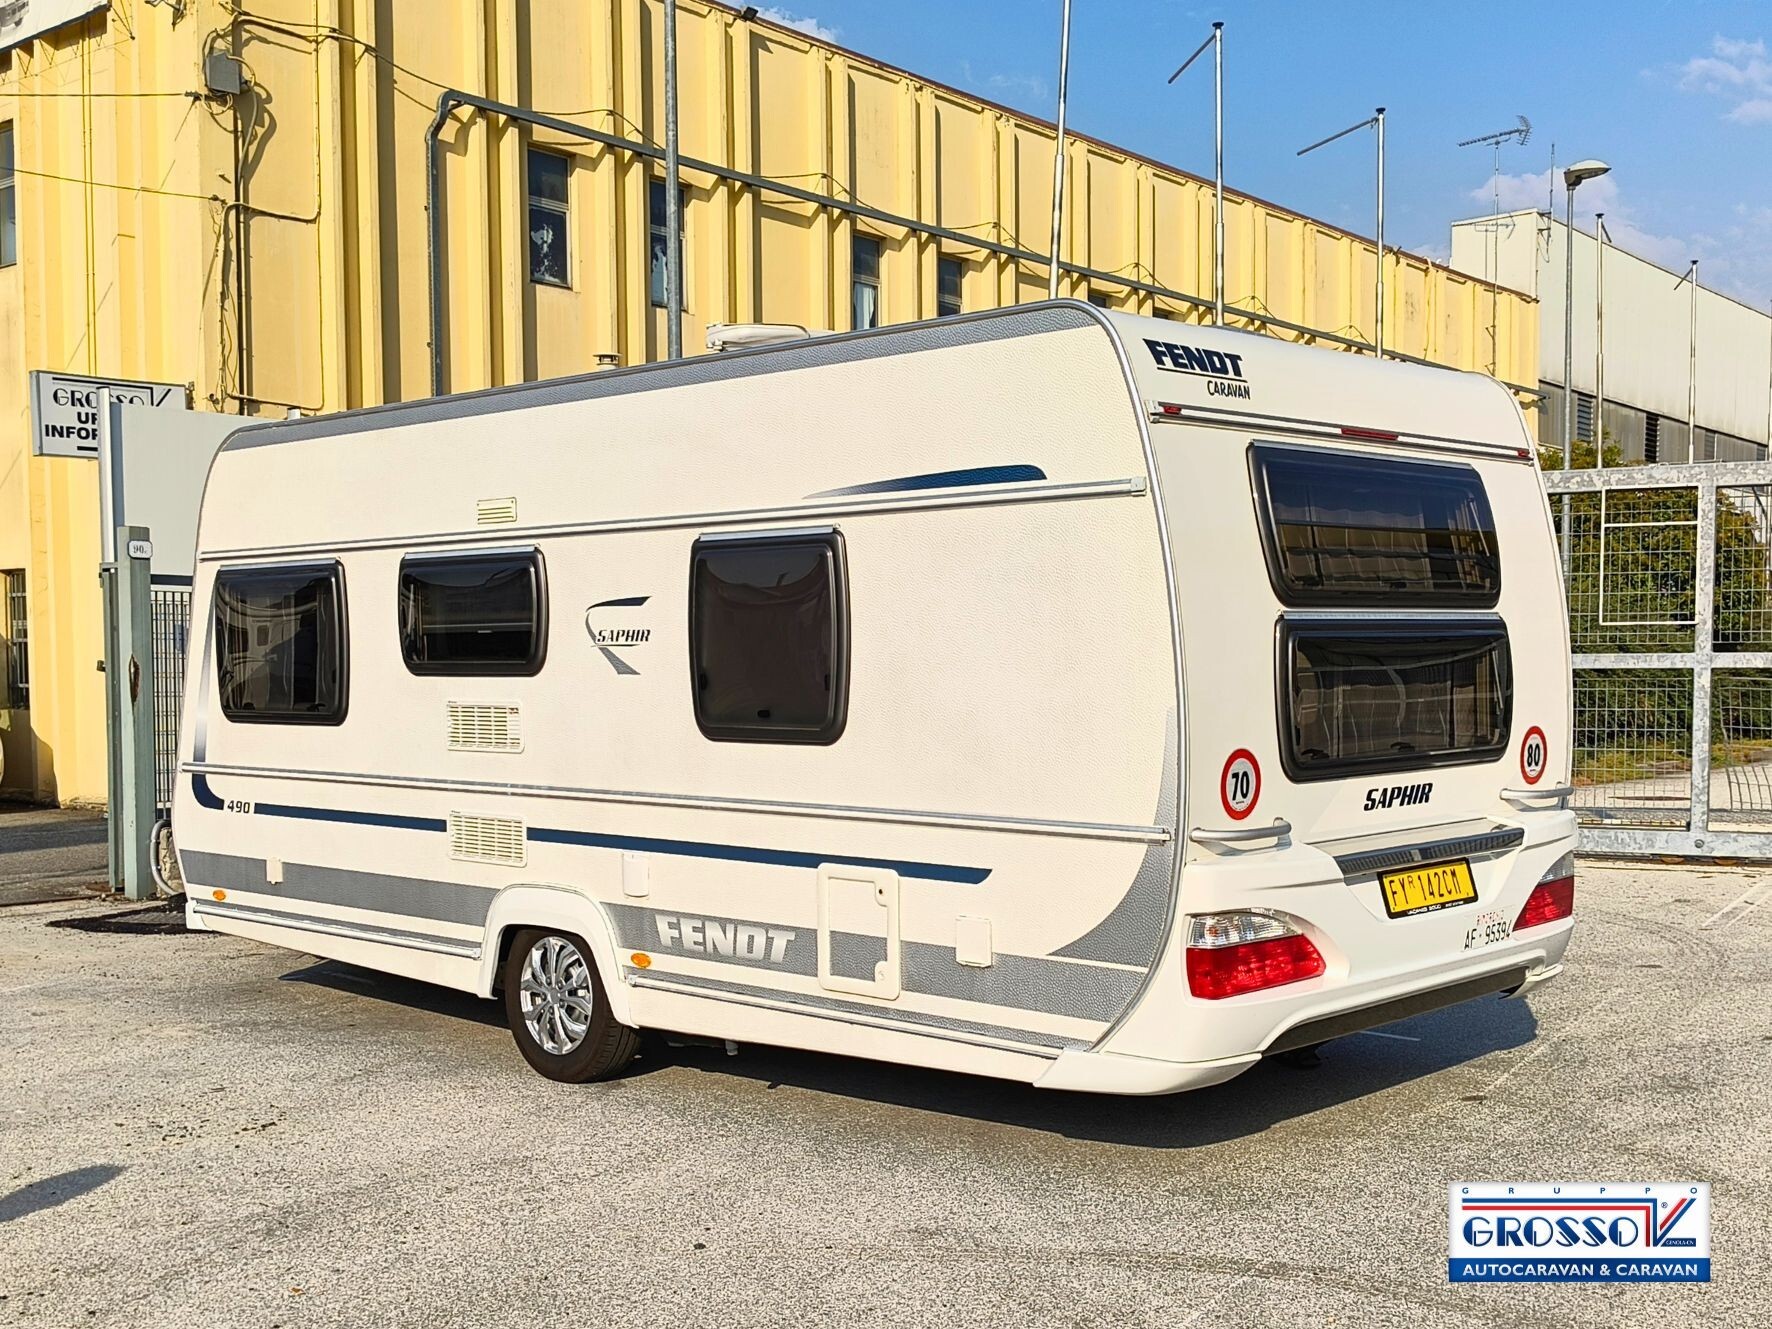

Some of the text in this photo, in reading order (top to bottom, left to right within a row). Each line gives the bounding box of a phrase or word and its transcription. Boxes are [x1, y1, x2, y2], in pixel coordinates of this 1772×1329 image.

[1142, 338, 1243, 377] FENDT
[1207, 380, 1251, 400] CARAVAN
[597, 629, 651, 642] SAPHIR
[1527, 743, 1541, 767] 80
[1231, 770, 1250, 801] 70
[1363, 782, 1433, 812] SAPHIR
[227, 799, 251, 814] 490
[654, 913, 796, 963] FENDT
